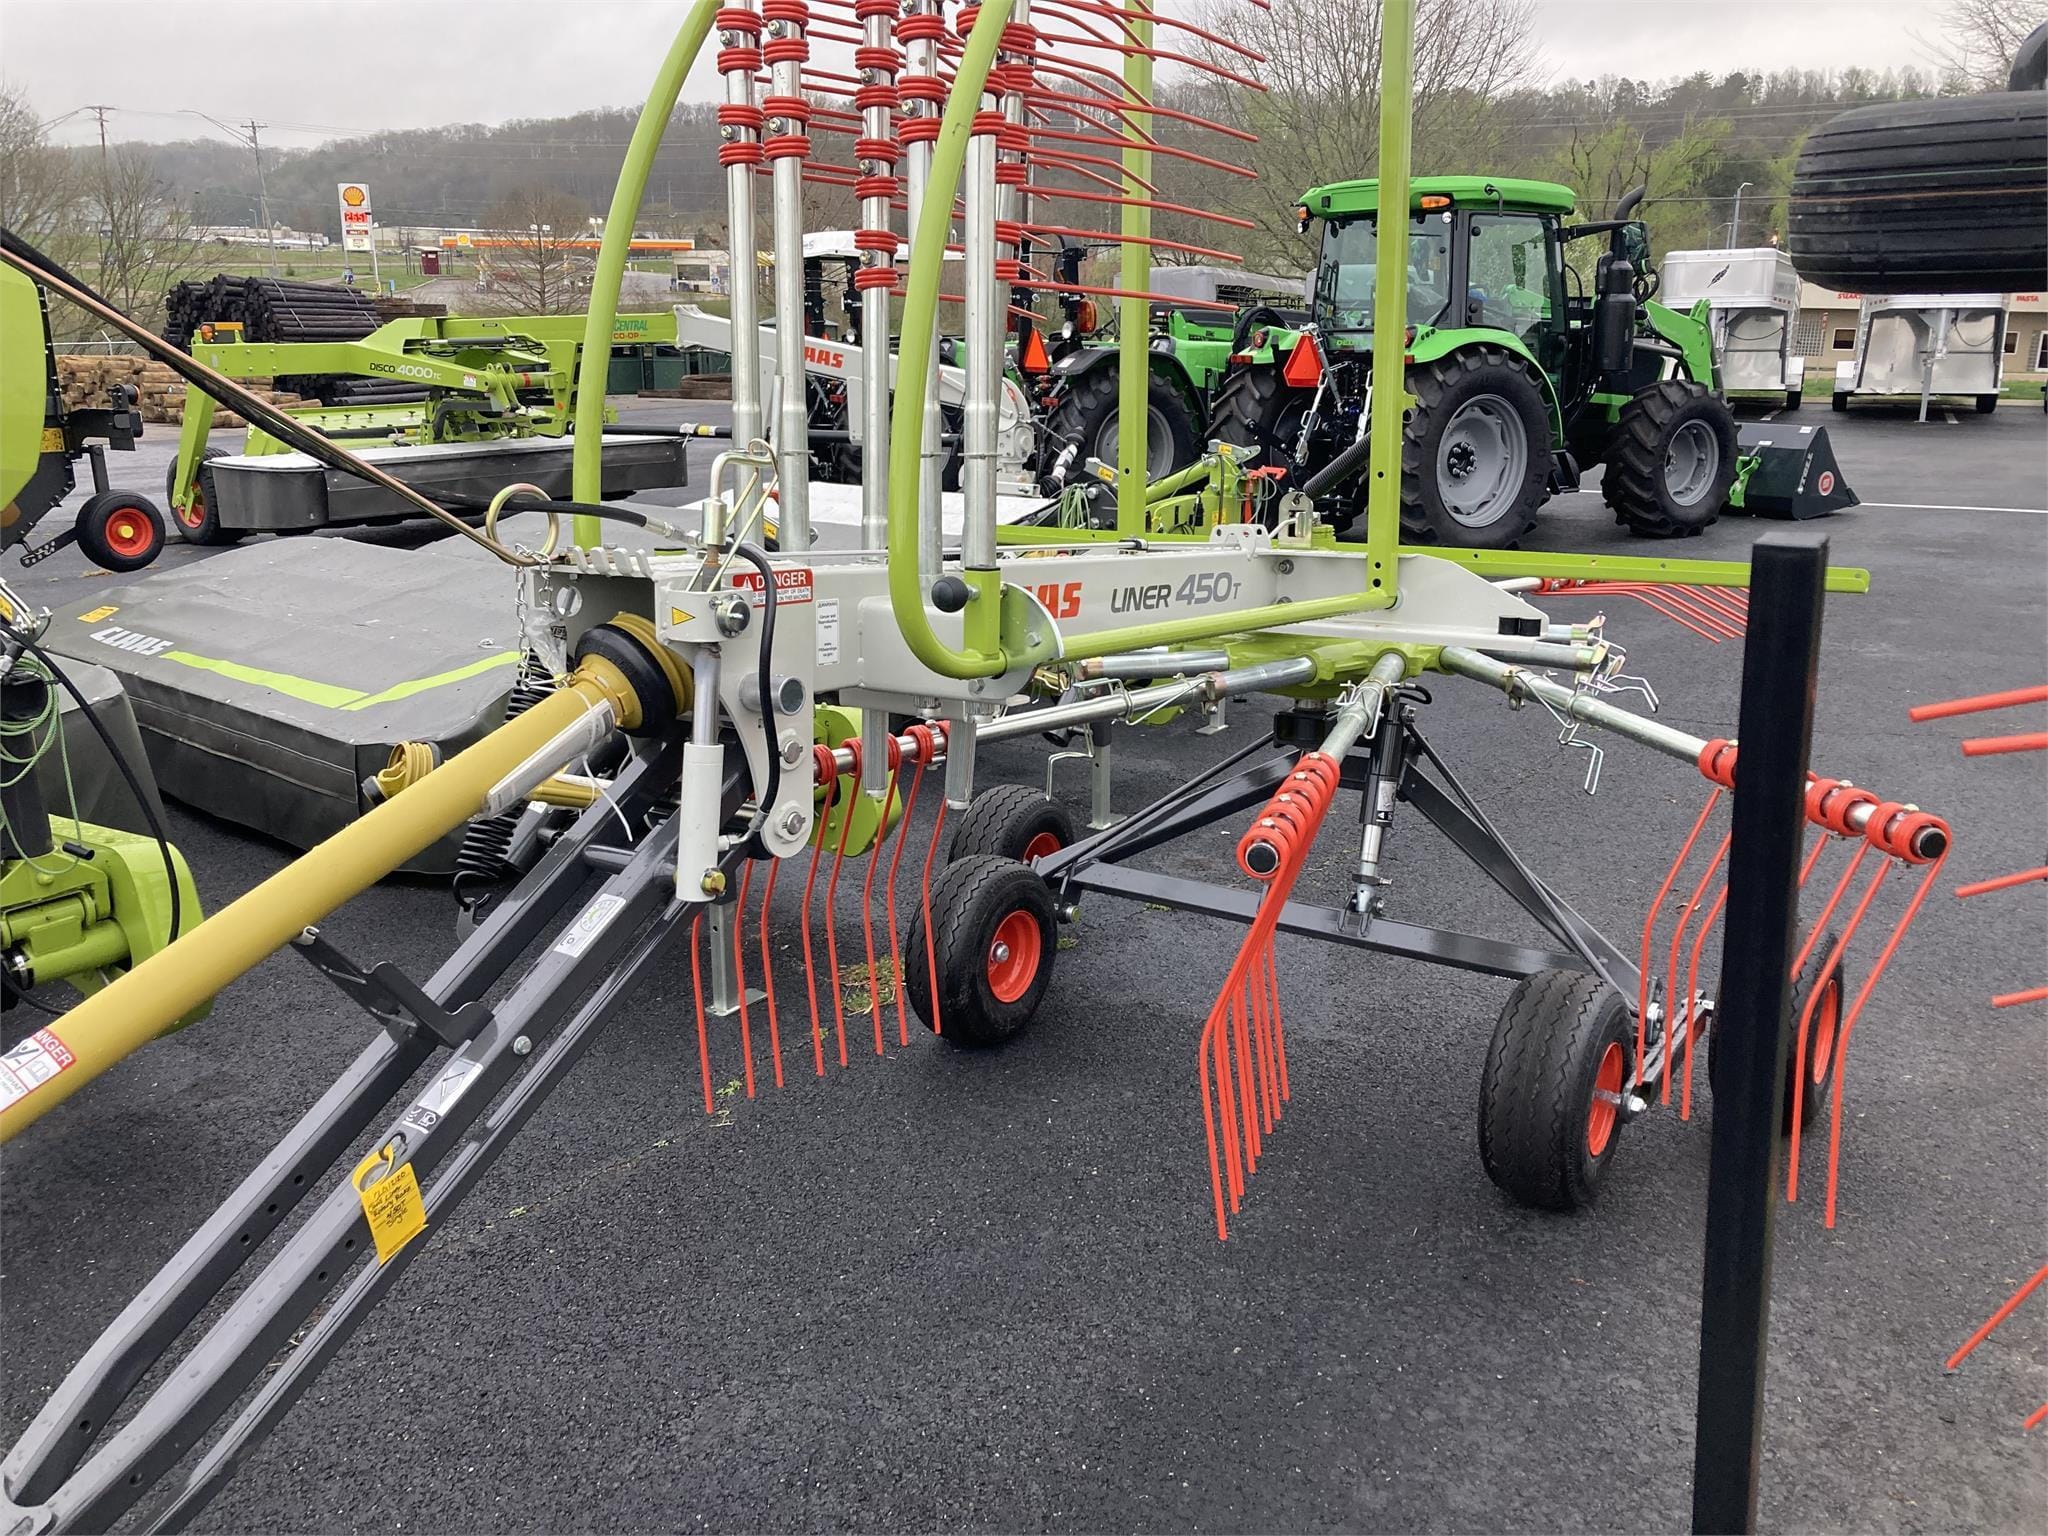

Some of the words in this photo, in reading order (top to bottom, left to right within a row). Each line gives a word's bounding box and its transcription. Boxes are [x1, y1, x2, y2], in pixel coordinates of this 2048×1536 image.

[614, 319, 648, 331] CENTRAL
[804, 347, 843, 368] AAS
[369, 362, 395, 373] DISCO
[756, 571, 806, 589] DNGER
[1110, 584, 1171, 613] LINER
[89, 626, 174, 656] CLAAS
